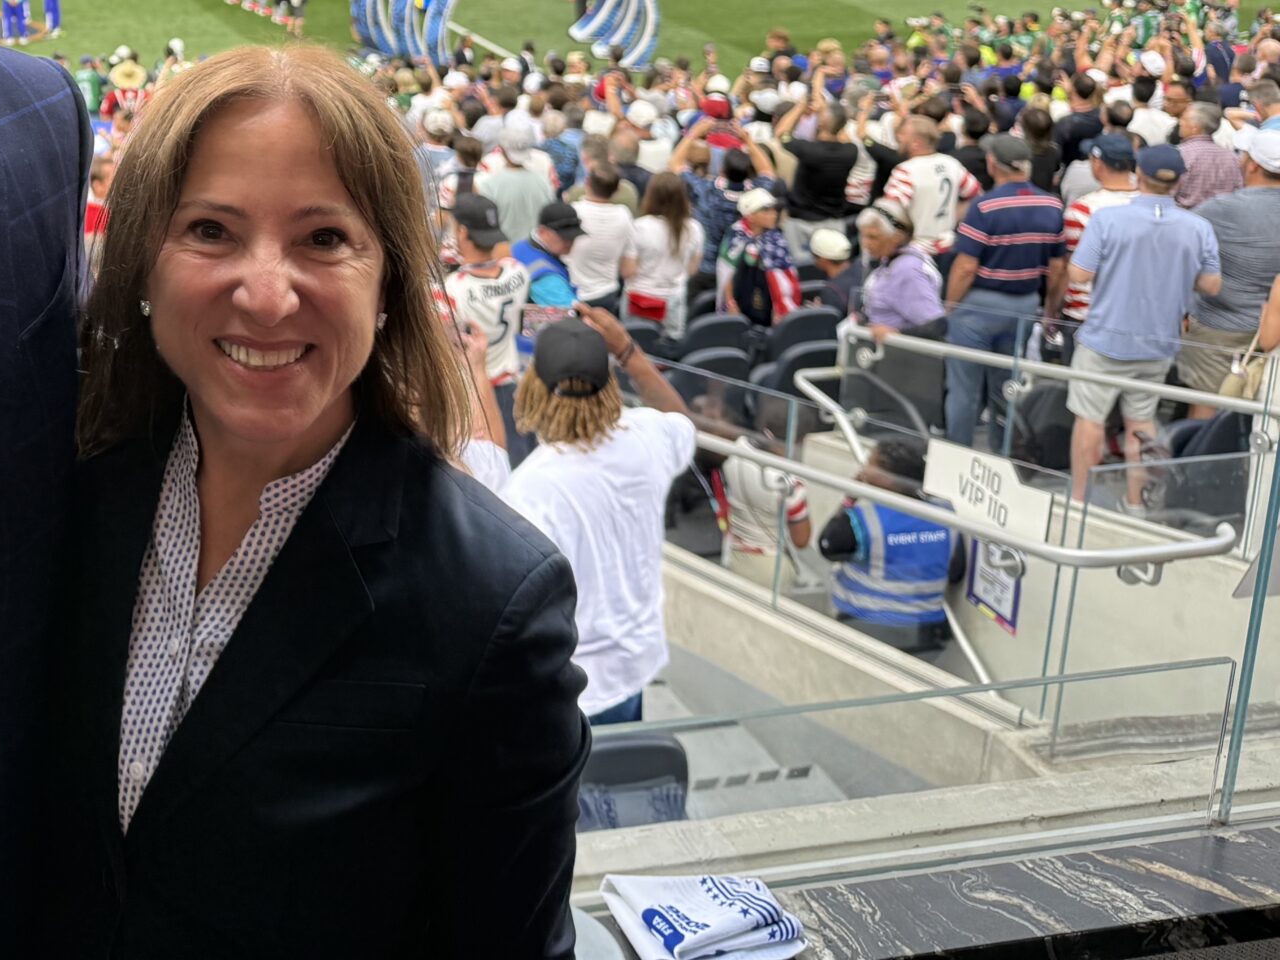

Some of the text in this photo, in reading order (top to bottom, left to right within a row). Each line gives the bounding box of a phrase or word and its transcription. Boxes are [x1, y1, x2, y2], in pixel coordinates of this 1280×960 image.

[934, 177, 953, 219] 2
[489, 298, 513, 346] 5
[958, 474, 984, 509] VIP
[887, 530, 946, 546] EVENT STAFF
[652, 914, 674, 937] FIFA
